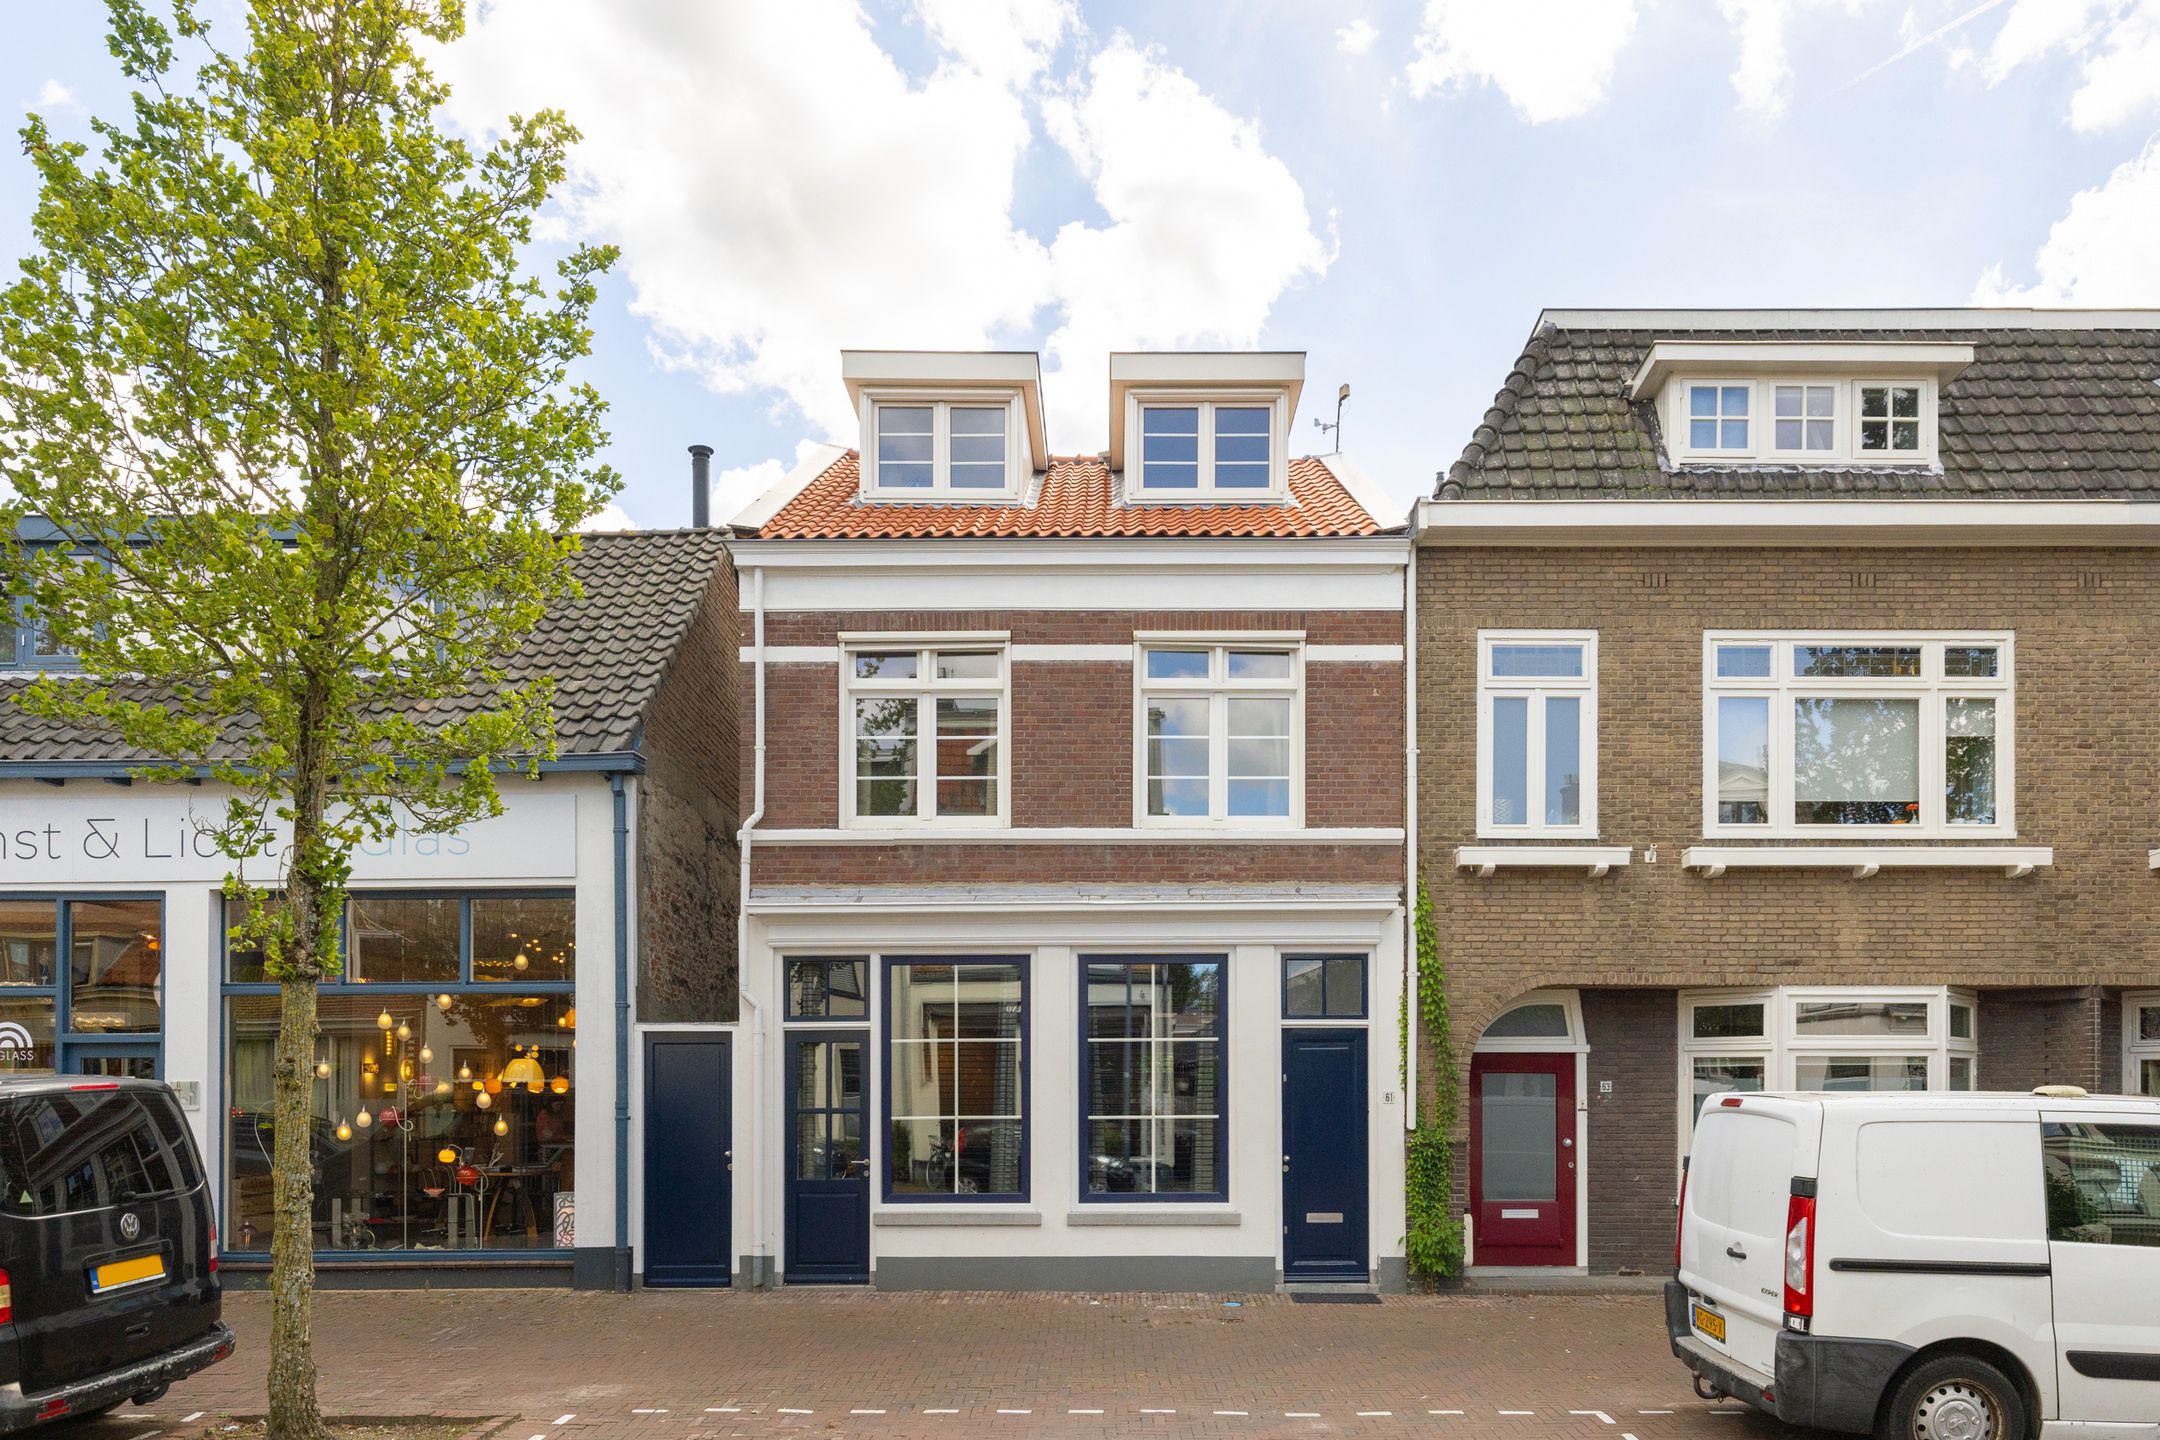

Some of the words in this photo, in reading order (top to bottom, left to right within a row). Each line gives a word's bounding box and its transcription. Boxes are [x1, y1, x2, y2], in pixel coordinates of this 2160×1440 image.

[83, 818, 121, 860] &
[1602, 1082, 1610, 1091] 63
[1385, 1092, 1393, 1102] 61
